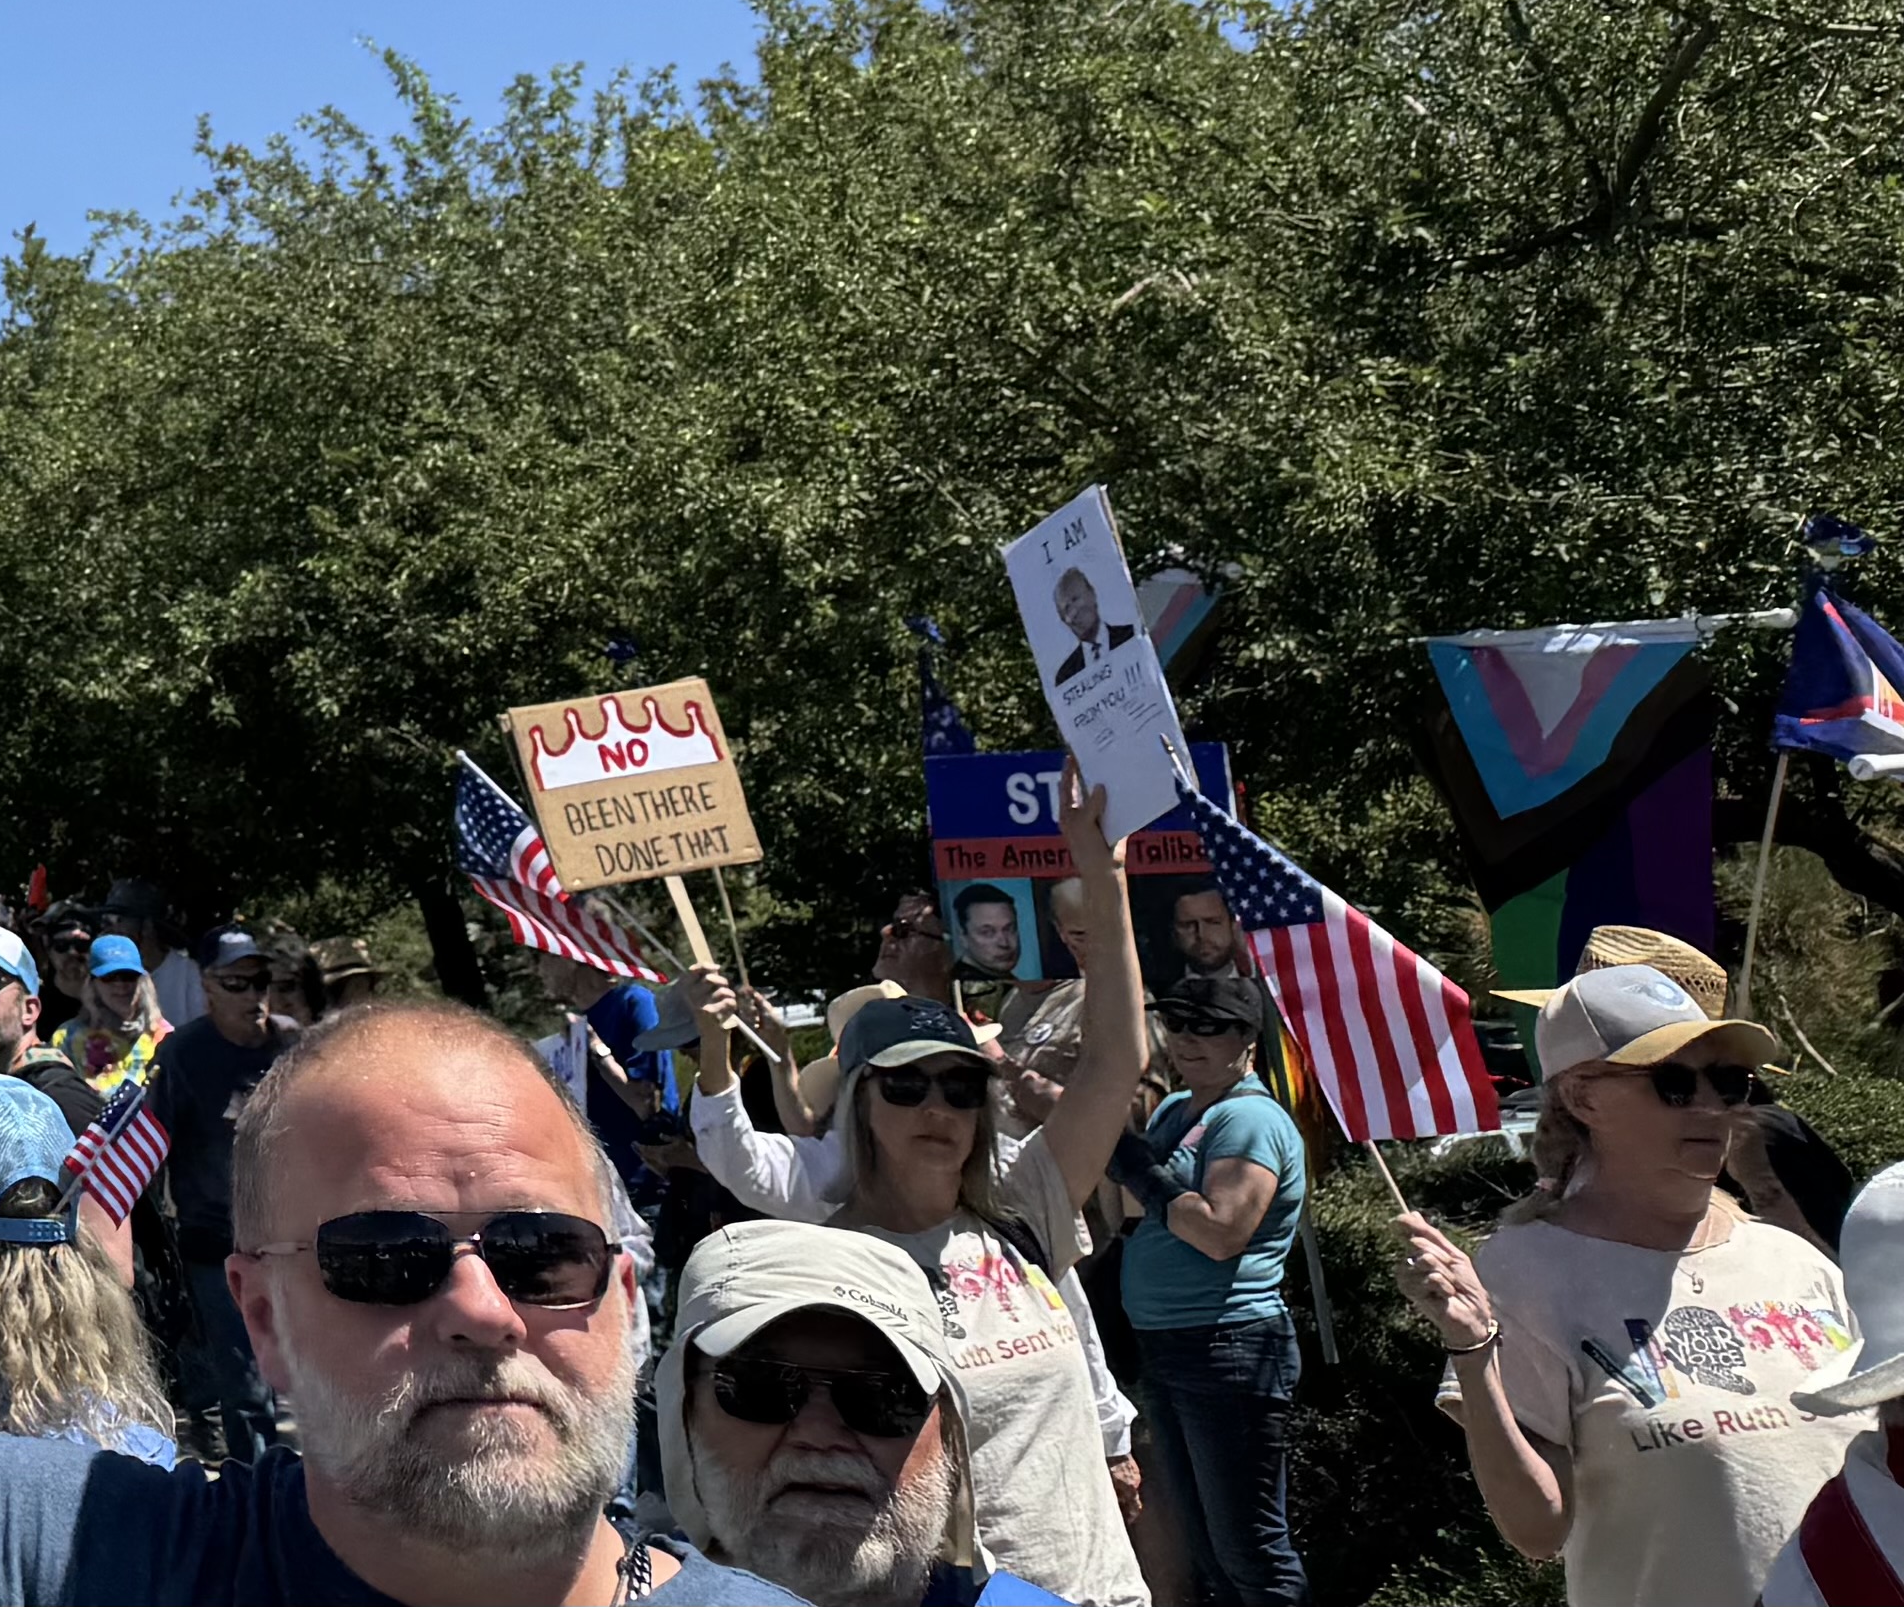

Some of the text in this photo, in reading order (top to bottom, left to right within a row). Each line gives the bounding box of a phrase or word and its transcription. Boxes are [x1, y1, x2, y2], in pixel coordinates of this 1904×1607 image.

[1042, 517, 1089, 566] I AM
[598, 738, 649, 773] NO
[564, 781, 717, 837] BEEN THERE
[1006, 770, 1062, 825] ST
[595, 825, 731, 877] DONE THAT
[944, 846, 986, 869] The
[951, 1344, 994, 1370] uth
[999, 1329, 1054, 1360] sent
[1667, 1345, 1743, 1366] VOICE
[1670, 1327, 1739, 1354] YOUR
[1630, 1417, 1703, 1452] Like
[1714, 1405, 1789, 1436] Ruth
